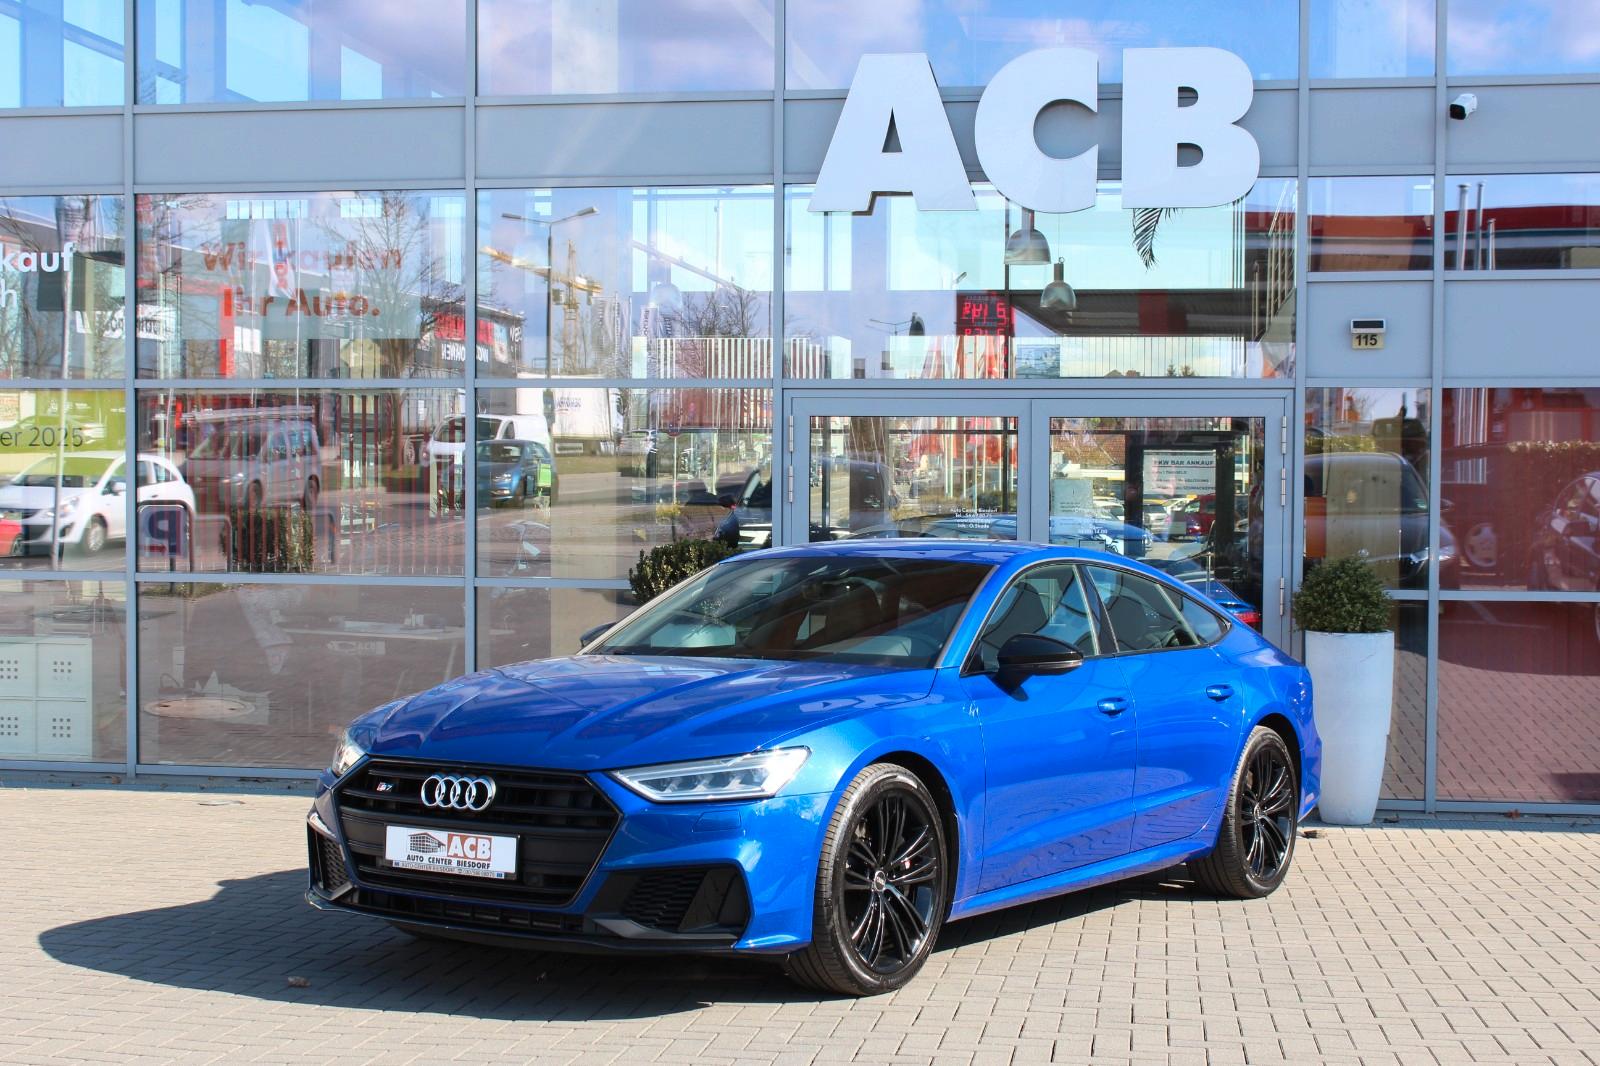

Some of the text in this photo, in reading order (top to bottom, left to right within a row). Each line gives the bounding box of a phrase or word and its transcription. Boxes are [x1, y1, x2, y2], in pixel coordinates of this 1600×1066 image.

[807, 47, 1260, 213] ACB
[1355, 334, 1378, 346] 115
[28, 427, 83, 447] 2025
[447, 835, 491, 861] ACB
[407, 854, 491, 870] AUTO CENTER BIESDORF
